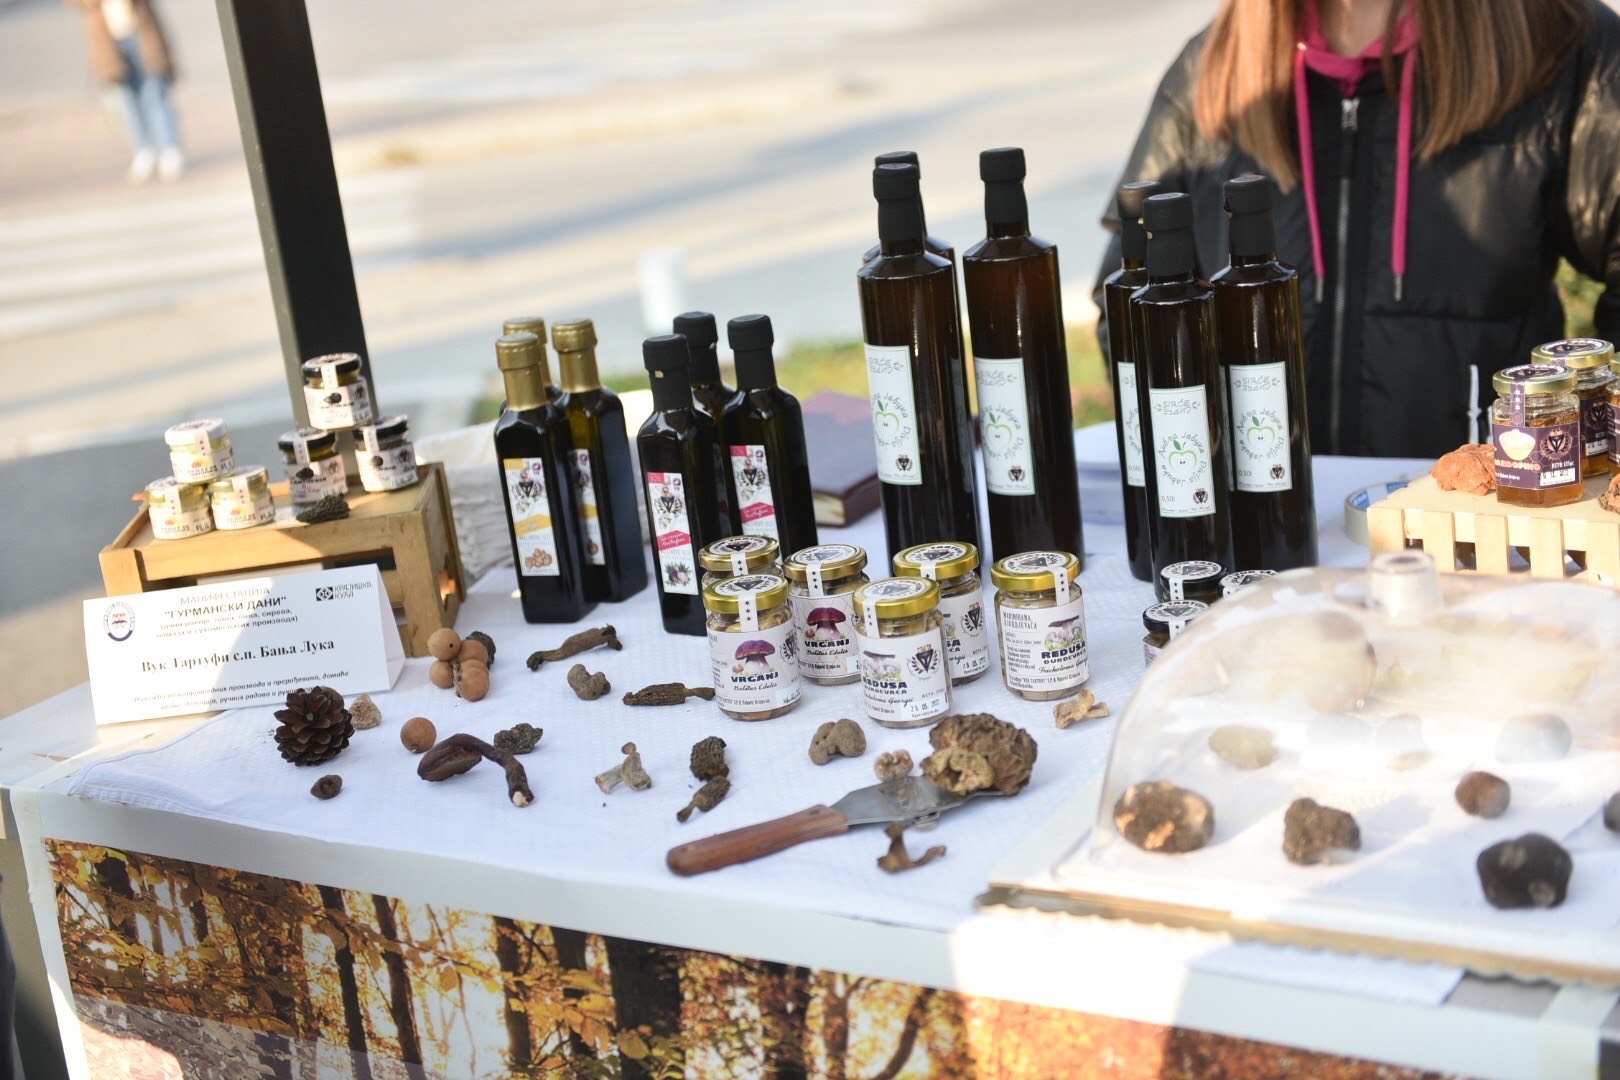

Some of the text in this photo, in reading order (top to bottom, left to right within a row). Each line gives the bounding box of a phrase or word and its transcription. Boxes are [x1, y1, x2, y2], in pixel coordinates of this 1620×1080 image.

[164, 596, 286, 619] "ГУРМАНСКИ ДАНИ"
[260, 644, 296, 659] Бања
[300, 640, 335, 655] Лука
[804, 638, 850, 648] VRGANJ
[730, 671, 779, 683] VRGANJ
